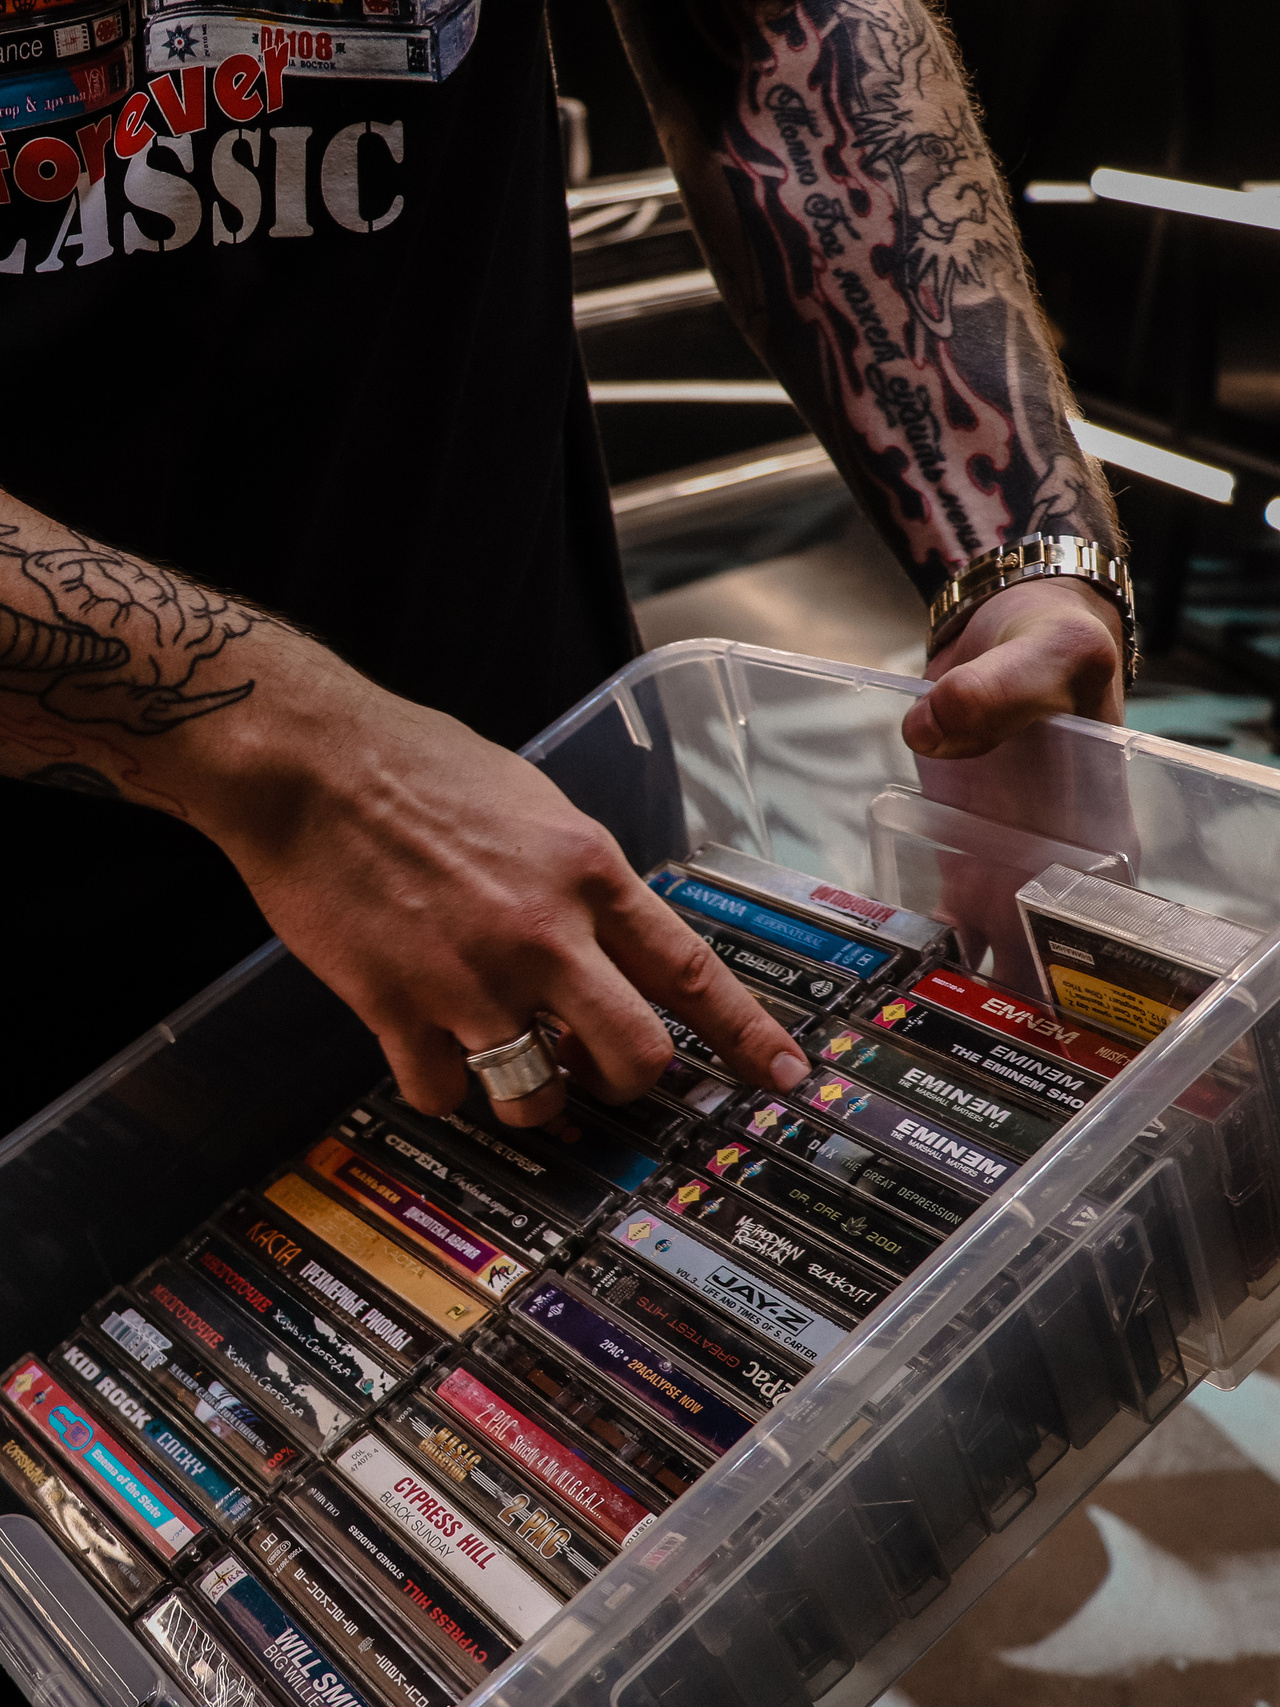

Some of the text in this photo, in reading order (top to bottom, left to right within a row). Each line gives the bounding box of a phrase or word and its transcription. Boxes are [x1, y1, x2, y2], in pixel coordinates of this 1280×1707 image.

[25, 96, 37, 112] &
[680, 885, 749, 918] SANTANA
[903, 1067, 1012, 1124] EMINEM
[950, 1043, 1087, 1112] THE EMINEM SHO
[990, 1044, 1085, 1091] EMINEM
[898, 1079, 1000, 1130] THE MARSHALL MATHERS LP
[490, 1138, 548, 1176] ПЕТЕРБУРГ
[890, 1129, 995, 1186] THE MARSHALL MATHERS LP
[894, 1118, 1008, 1180] EMINEM
[807, 1138, 963, 1226] DMX THE GREAT DEPRESSION
[403, 1207, 447, 1245] ДИСКОТЕКА
[444, 1229, 482, 1260] АВАРИЯ
[788, 1188, 902, 1255] DR. DRE 2001
[199, 1251, 273, 1314] МНОГОТОЧИЕ
[245, 1221, 302, 1266] КАСТА
[299, 1260, 371, 1318] ТРЕХМЕРНЫЕ
[361, 1307, 414, 1352] РИФМЫ
[636, 1296, 668, 1321] HITS
[710, 1270, 810, 1332] JAY-Z
[808, 1263, 877, 1306] BLACKOUT!
[150, 1283, 225, 1350] МНОГОТОЧИЕ
[667, 1311, 740, 1368] GREATEST
[702, 1285, 720, 1300] LIFE
[721, 1295, 736, 1311] AND
[736, 1303, 761, 1325] TIMES
[761, 1320, 774, 1333] OF
[784, 1334, 817, 1361] CARTER
[598, 1339, 704, 1414] 2PAC 2PACALYPSE NOW
[62, 1346, 207, 1478] KID ROCK COCKY
[350, 1448, 366, 1461] COL
[431, 1426, 483, 1472] MUSIC
[489, 1407, 521, 1442] PAC
[508, 1433, 540, 1468] Strictly
[543, 1458, 561, 1483] My
[90, 1448, 163, 1520] Enema of the State
[379, 1490, 456, 1560] BLACK SUNDAY
[393, 1476, 498, 1571] CYPRESS HILL
[496, 1494, 573, 1561] 2 PAC
[210, 1567, 246, 1600] ASTRA
[348, 1523, 488, 1664] CYPRESS HILL STONED RAIDERS
[262, 1644, 325, 1707] BIG WILLIE
[274, 1627, 315, 1679] WILL
[312, 1671, 364, 1707] SMI
